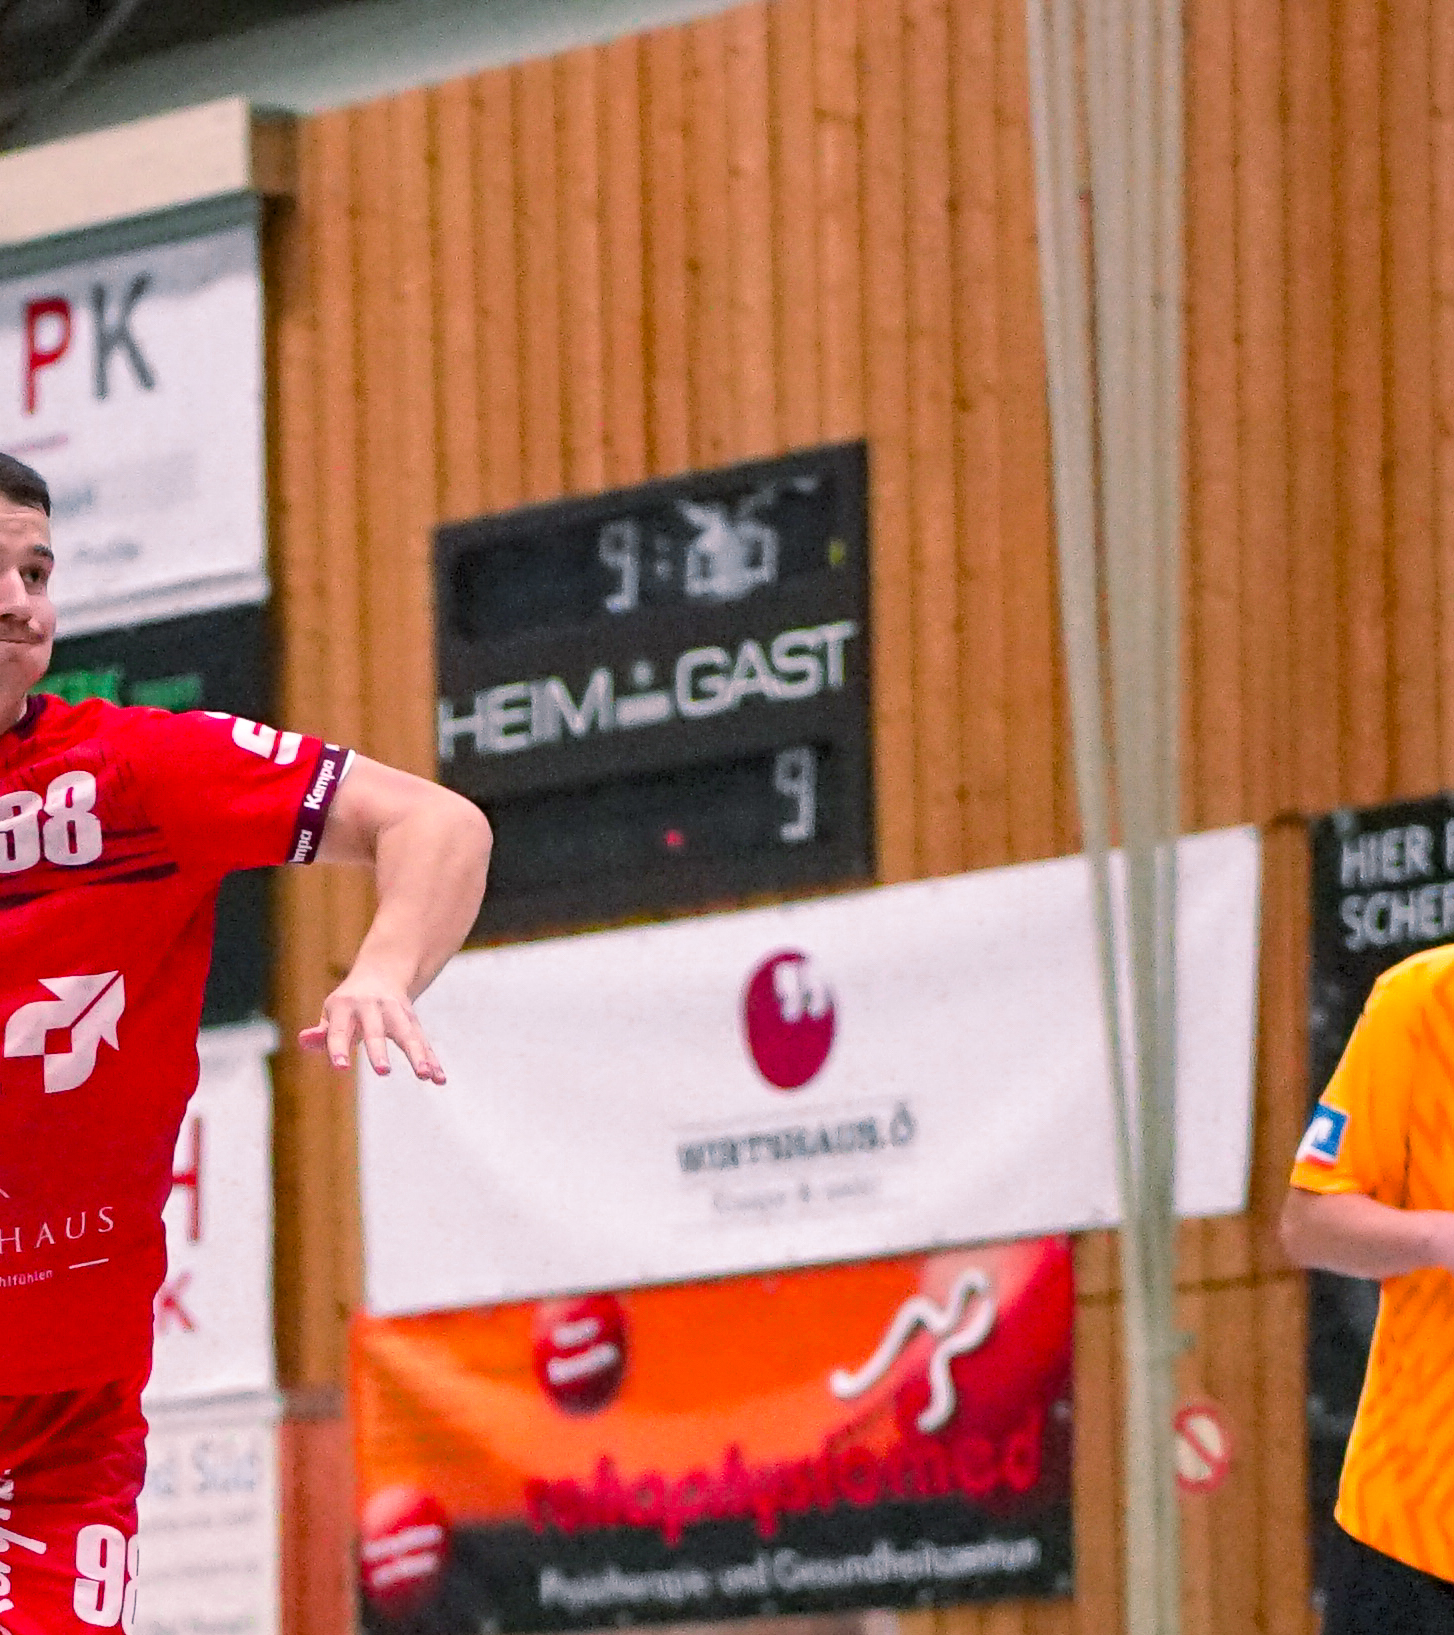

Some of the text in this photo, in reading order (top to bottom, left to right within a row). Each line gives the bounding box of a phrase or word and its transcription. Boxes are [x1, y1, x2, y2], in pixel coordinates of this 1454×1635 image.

[437, 619, 857, 763] HEIM GAST
[303, 758, 336, 811] Kempa
[773, 745, 818, 843] 9
[1341, 822, 1433, 886] HIER
